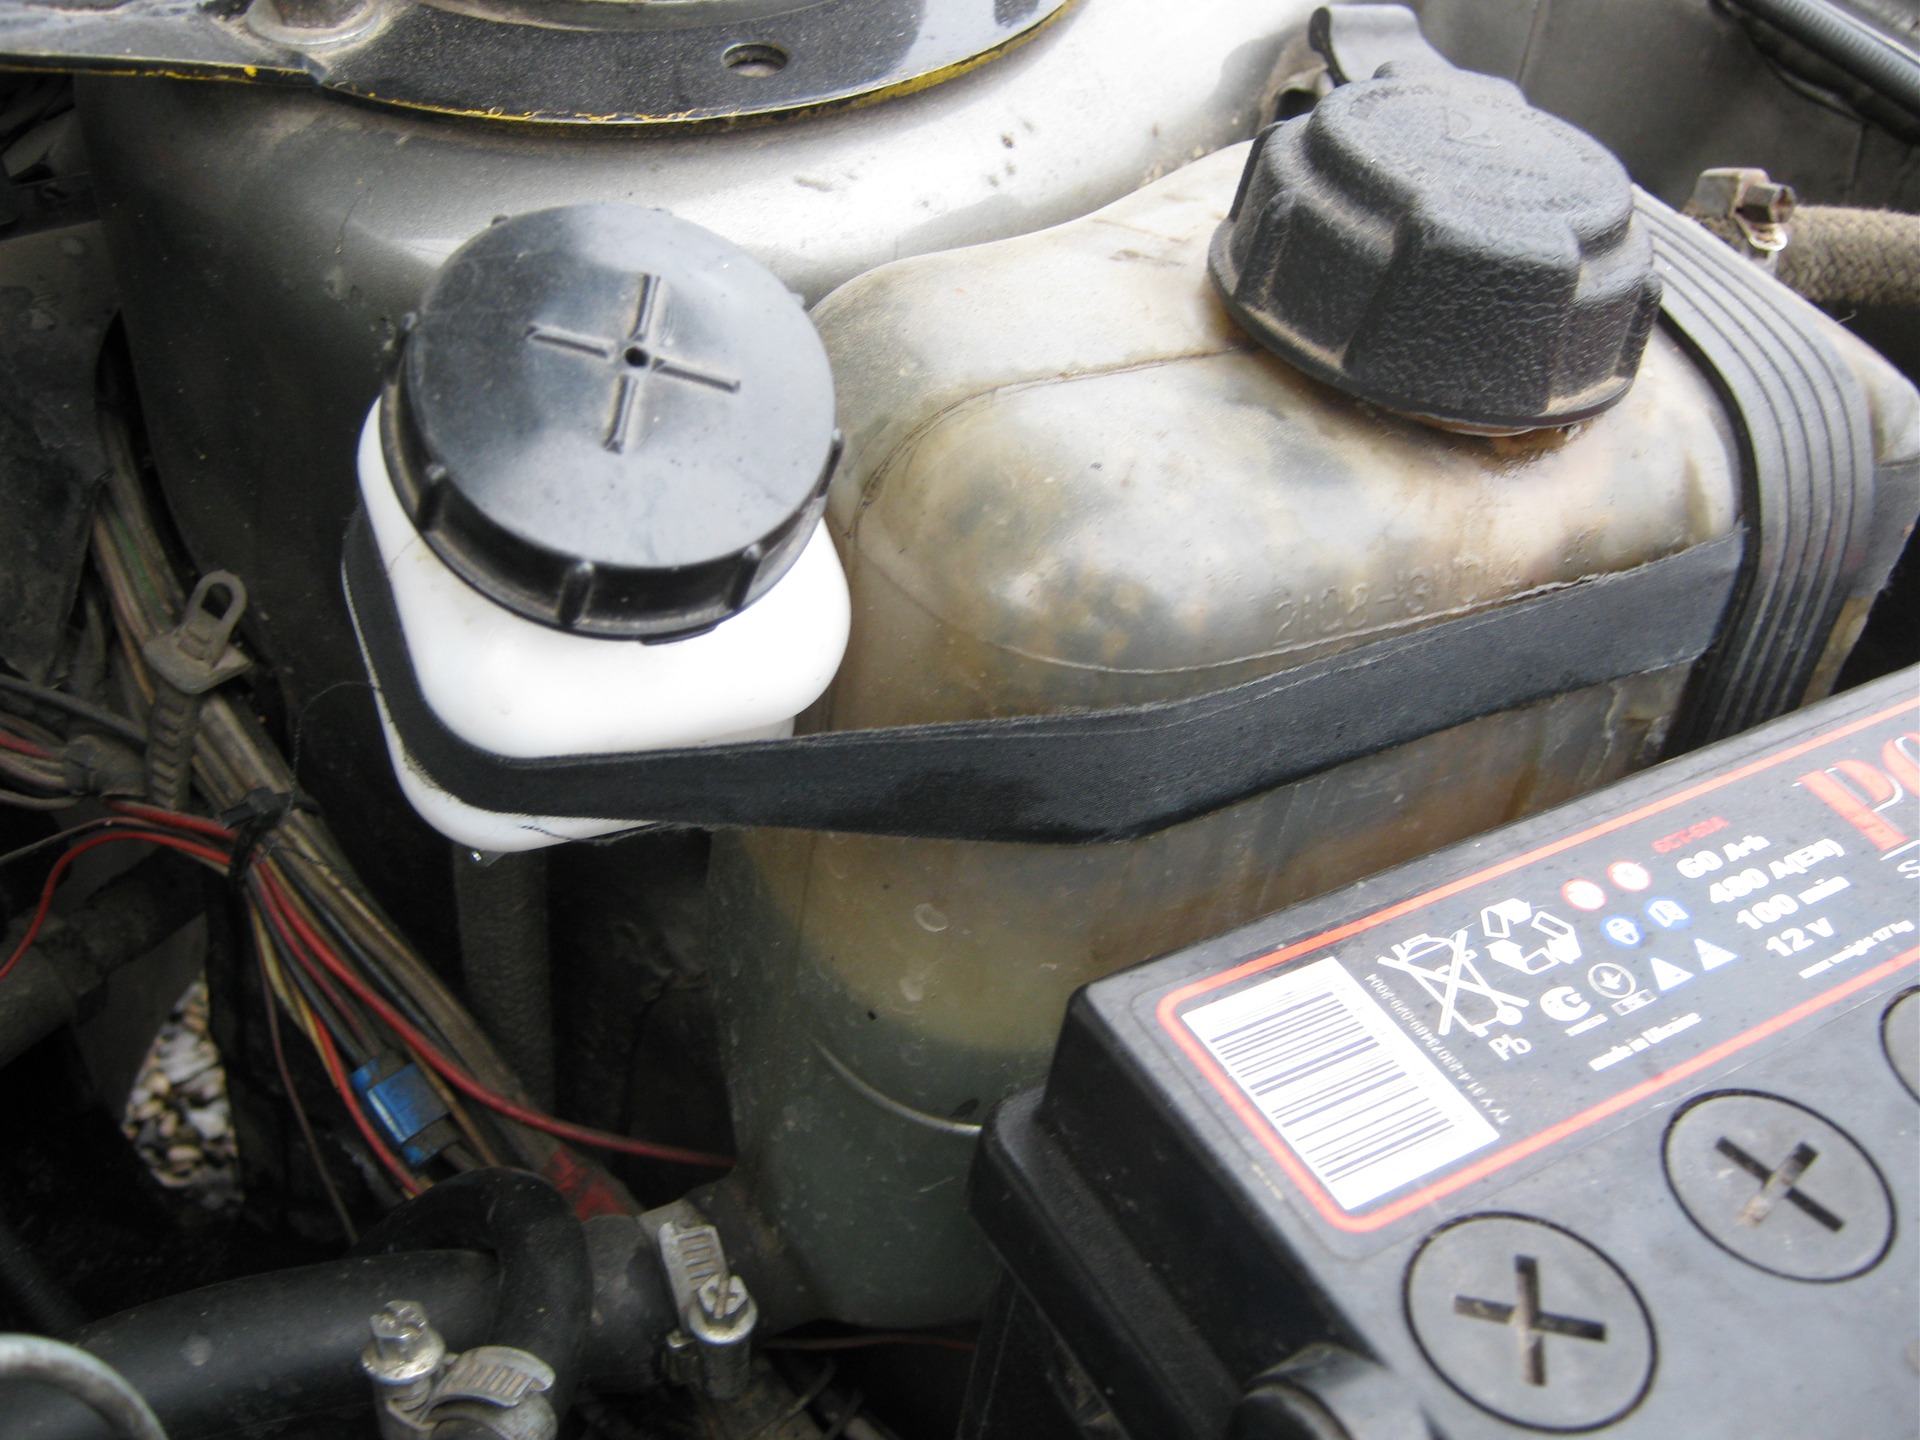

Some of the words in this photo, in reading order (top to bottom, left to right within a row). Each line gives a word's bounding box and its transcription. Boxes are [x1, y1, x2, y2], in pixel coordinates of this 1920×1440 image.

[1676, 850, 1723, 878] 60
[1709, 868, 1769, 904] 480
[1736, 893, 1799, 929] 100
[1765, 927, 1815, 957] 12
[1804, 917, 1834, 938] V
[1487, 1033, 1532, 1062] Pb
